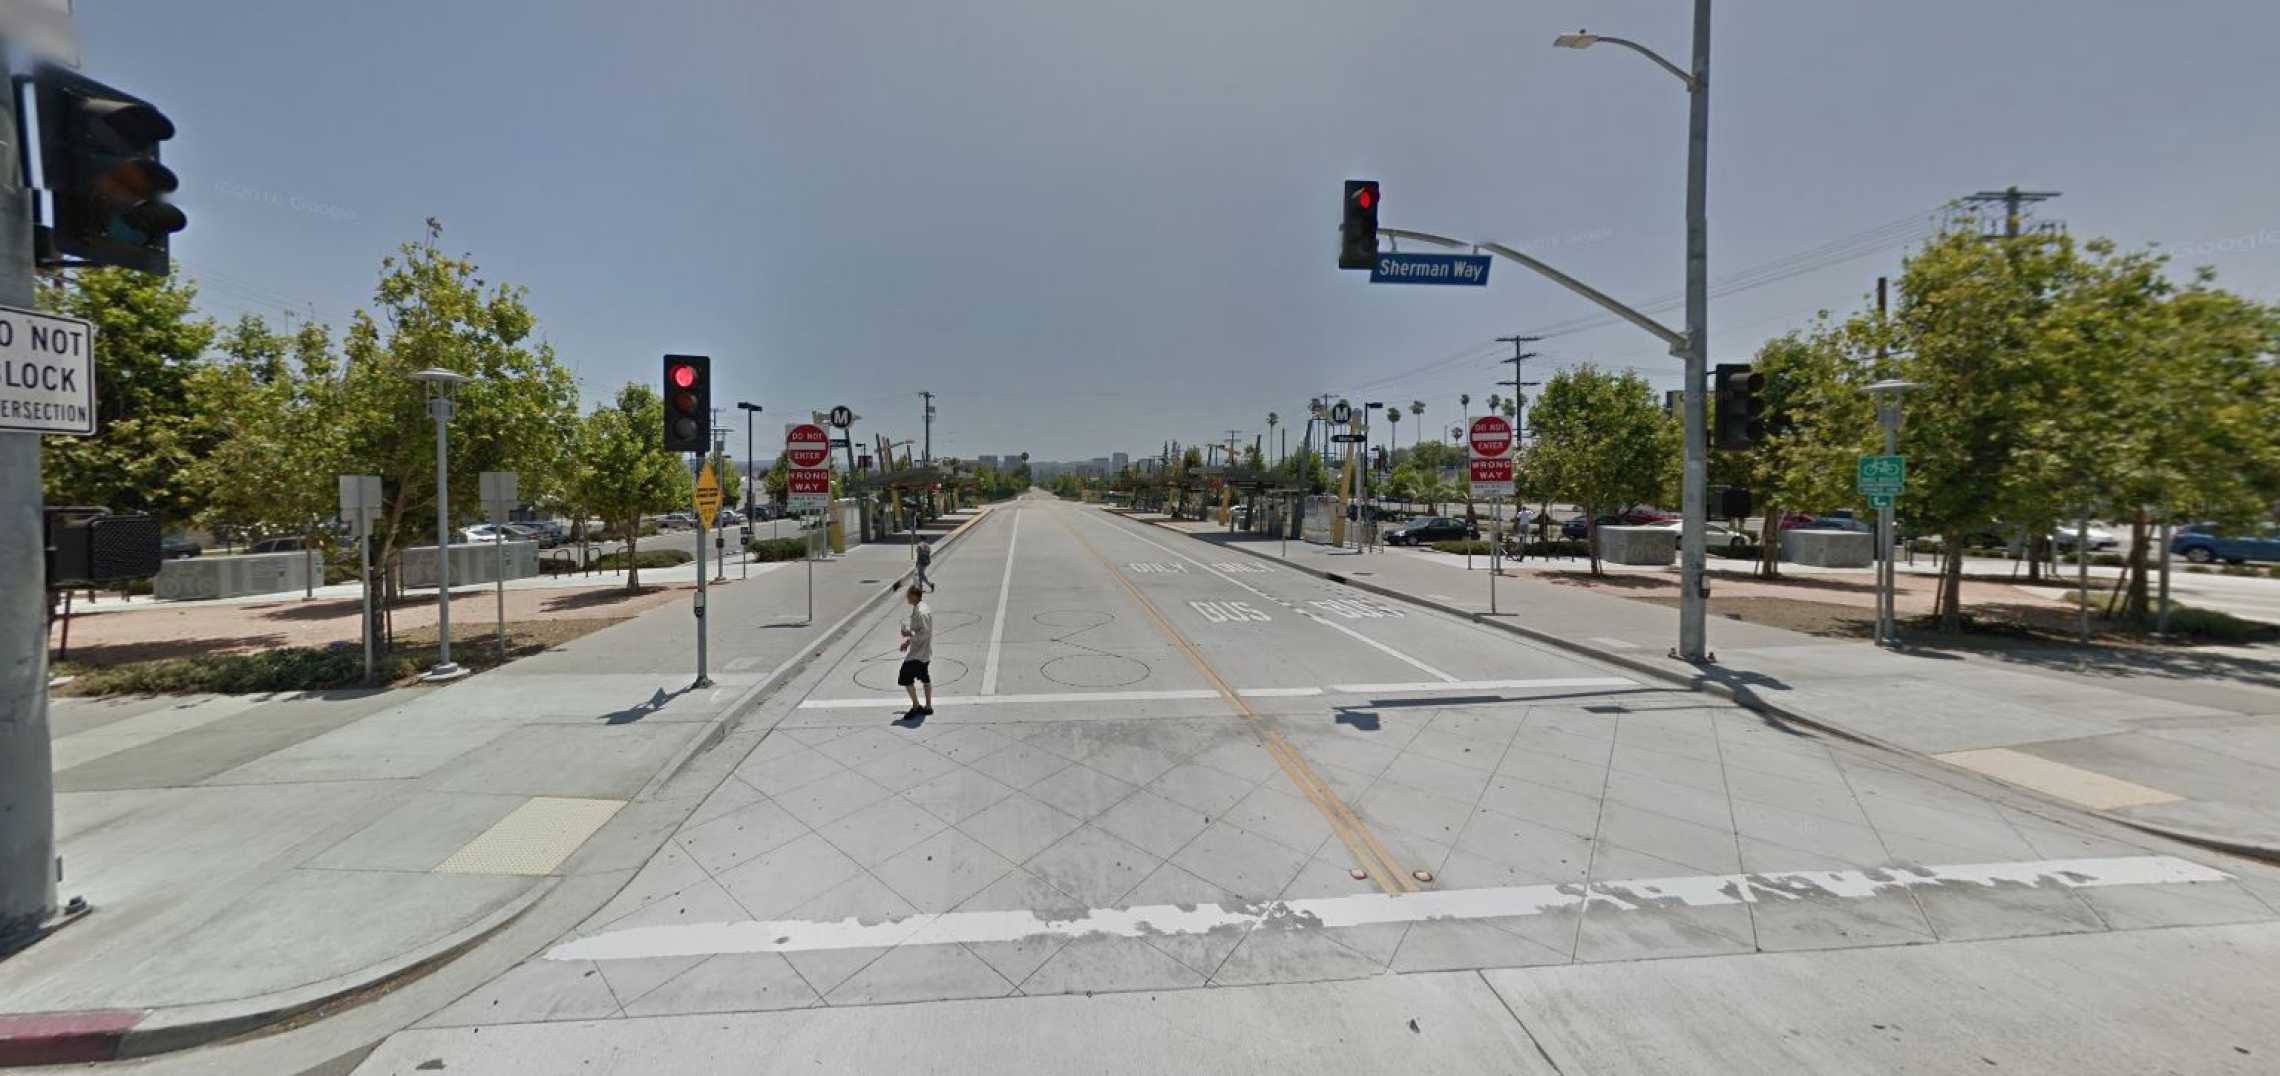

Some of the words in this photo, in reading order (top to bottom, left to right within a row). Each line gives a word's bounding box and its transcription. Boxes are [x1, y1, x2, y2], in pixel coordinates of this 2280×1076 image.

[1379, 259, 1448, 277] Sherman
[1453, 261, 1484, 282] Way
[0, 320, 13, 347] O
[32, 326, 83, 356] NOT
[0, 360, 77, 392] LOCK
[0, 399, 87, 423] ERSECTION
[1336, 406, 1348, 421] M
[834, 410, 848, 425] M
[1474, 423, 1487, 431] DO
[1490, 423, 1505, 431] NOT
[792, 432, 803, 440] DO
[807, 432, 823, 440] NOT
[1478, 441, 1504, 449] ENTER
[794, 451, 821, 460] ENTER
[1472, 460, 1511, 470] WRONG
[790, 471, 828, 481] WRONG
[1479, 471, 1504, 481] WAY
[795, 482, 819, 492] WAY
[1188, 600, 1273, 624] BUS
